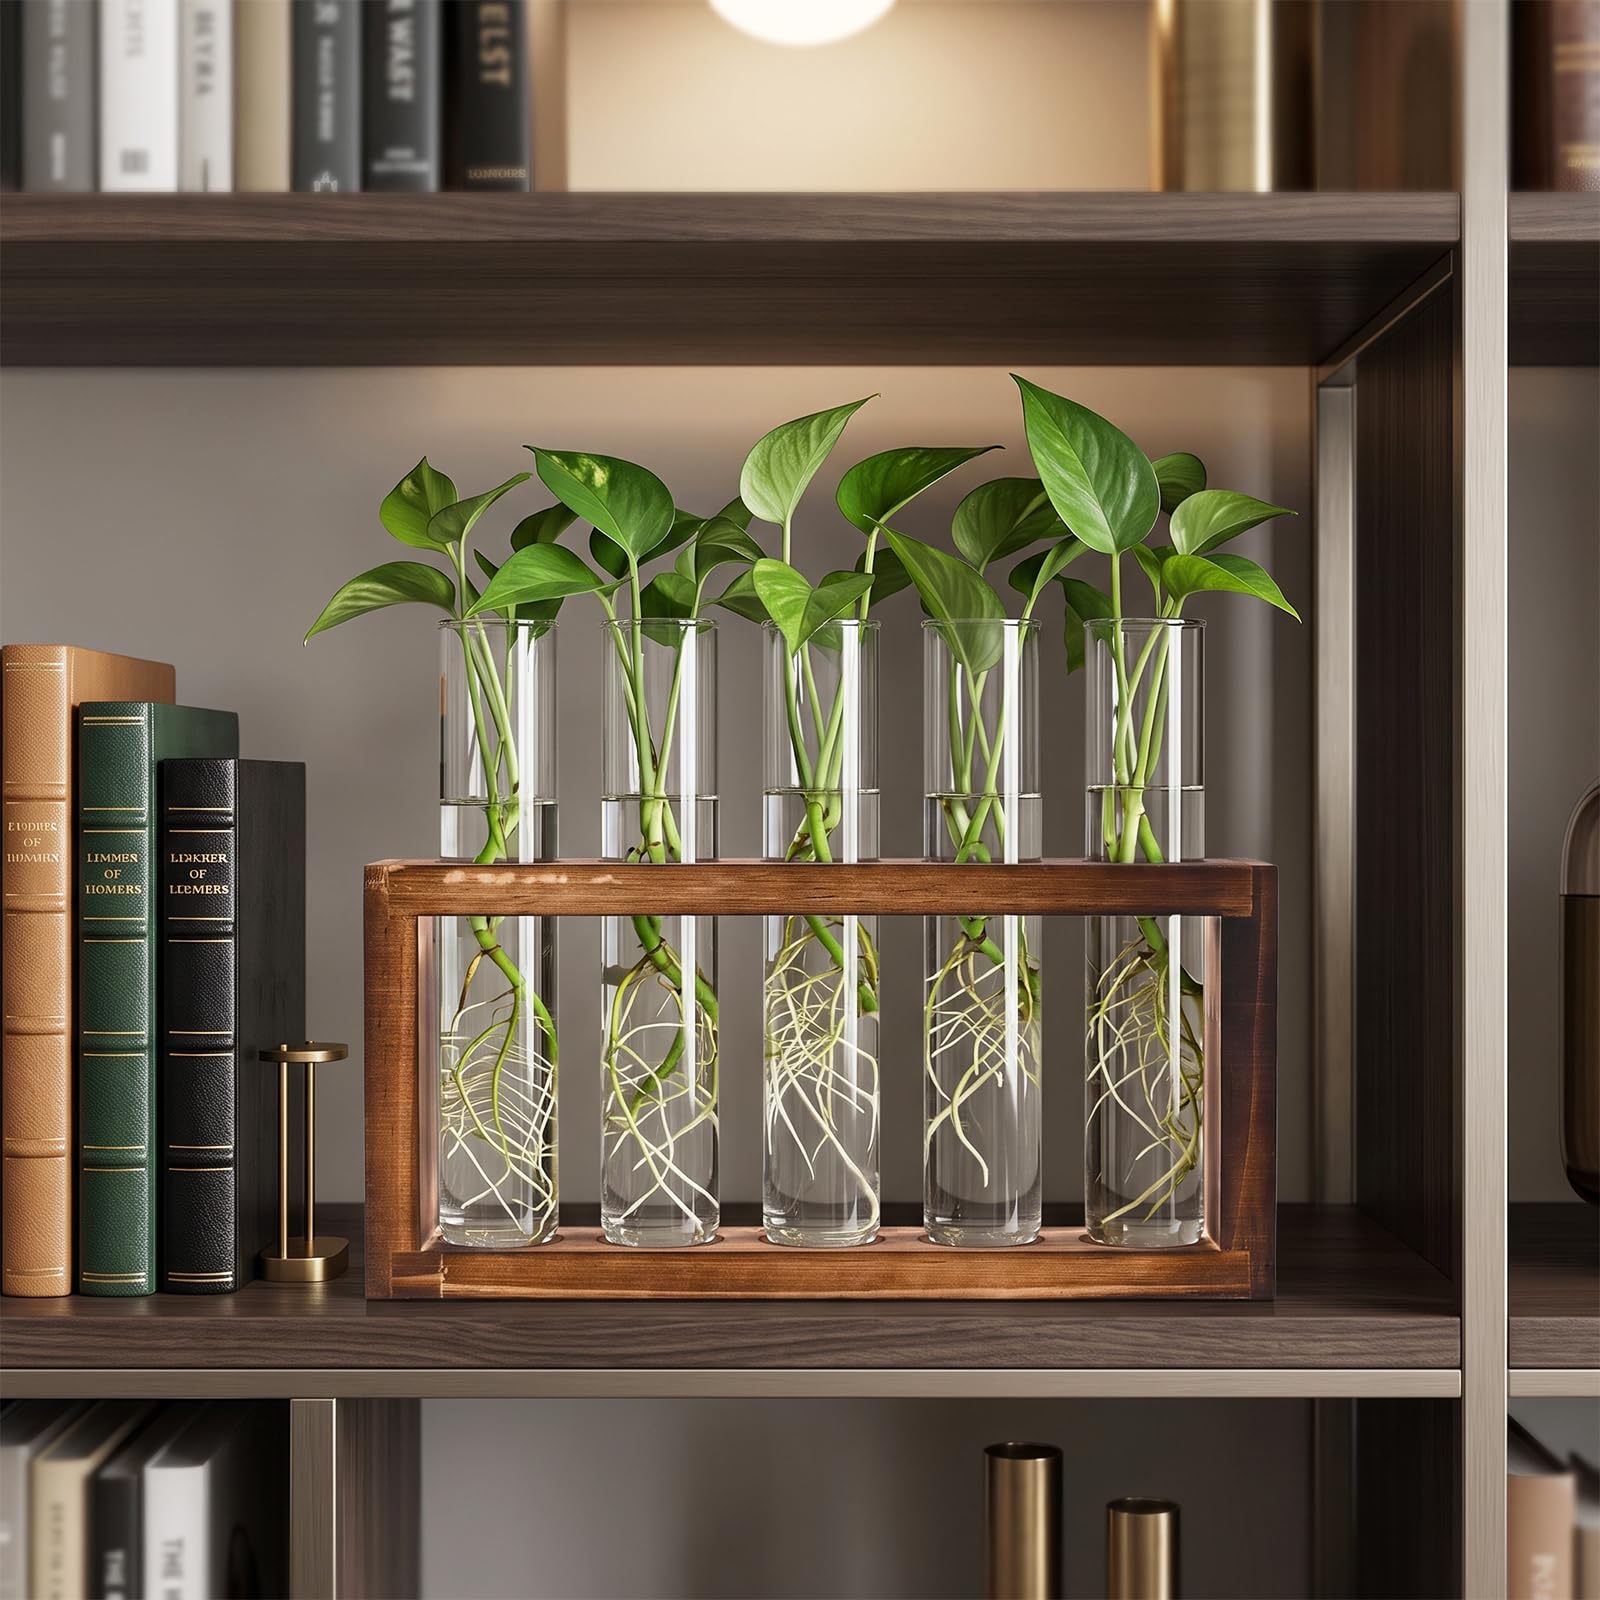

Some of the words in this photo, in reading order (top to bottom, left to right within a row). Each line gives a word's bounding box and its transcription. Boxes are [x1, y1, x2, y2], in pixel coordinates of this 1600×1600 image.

[23, 837, 41, 847] OF
[104, 869, 122, 879] OF
[189, 869, 207, 879] OF
